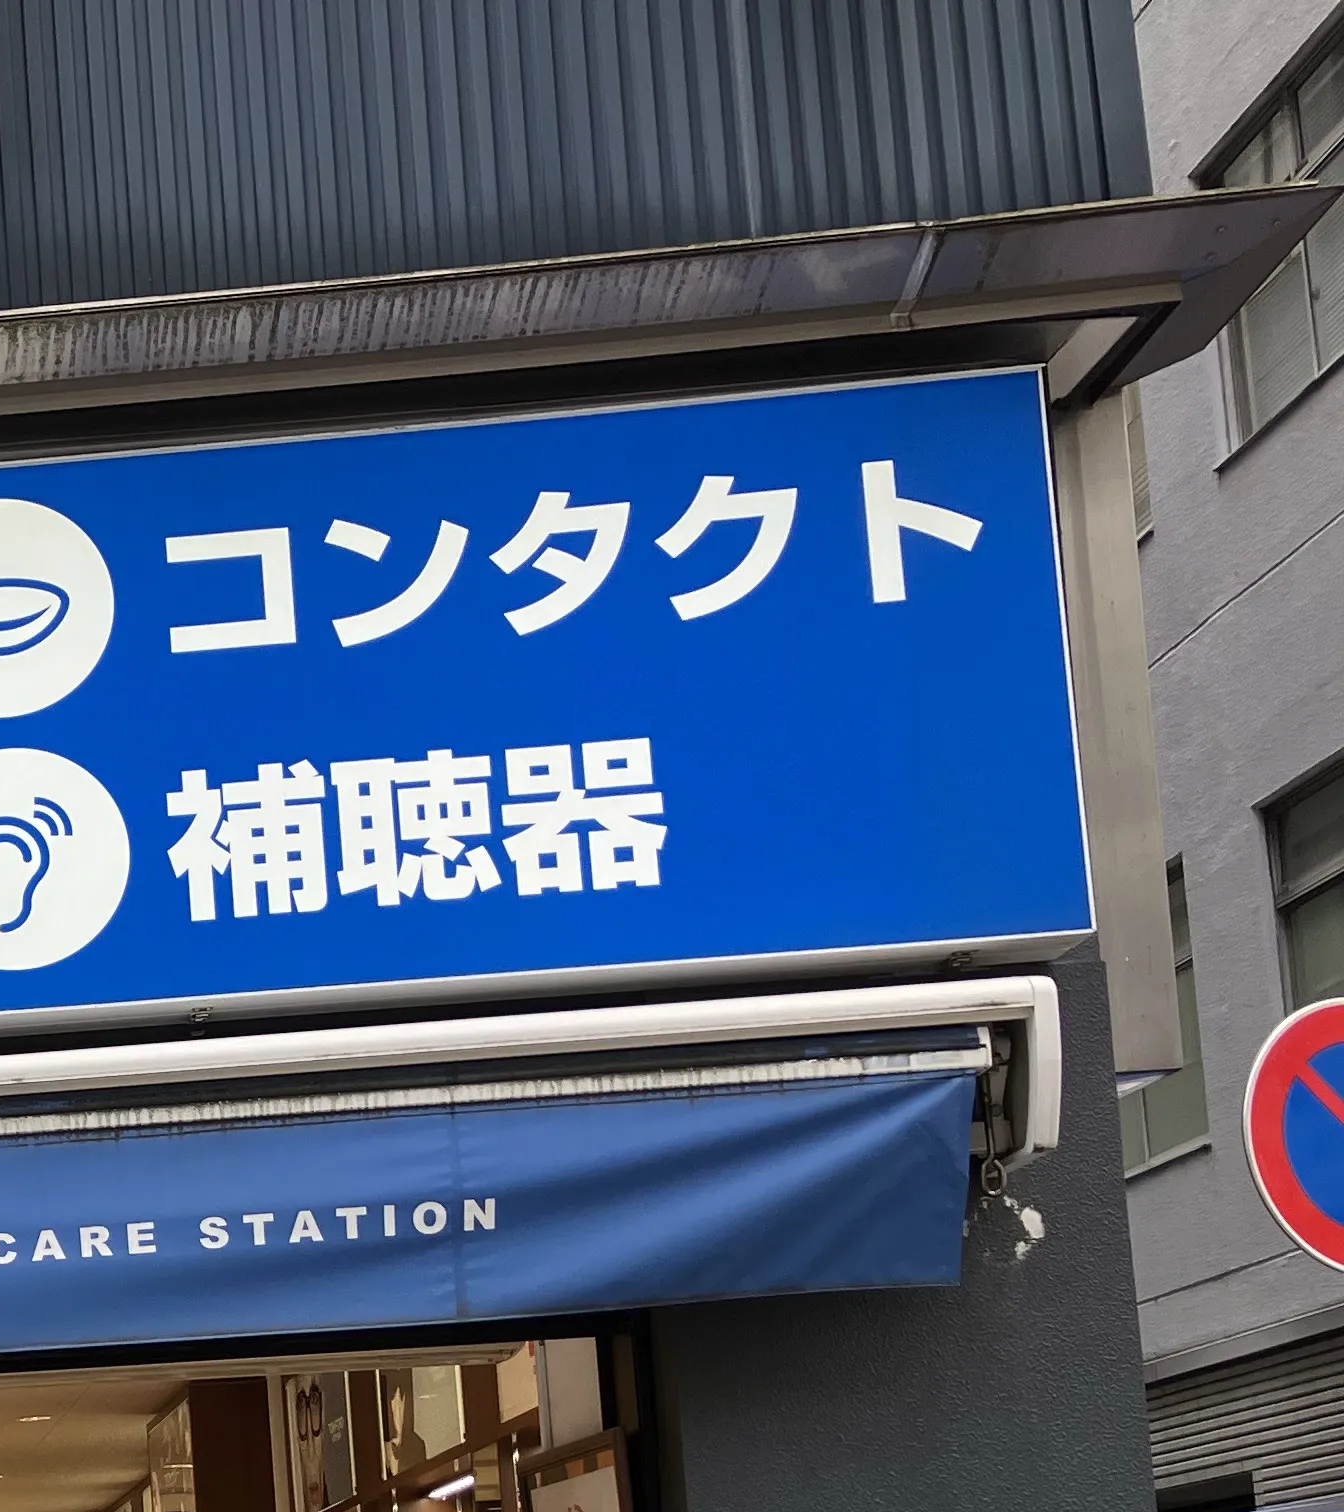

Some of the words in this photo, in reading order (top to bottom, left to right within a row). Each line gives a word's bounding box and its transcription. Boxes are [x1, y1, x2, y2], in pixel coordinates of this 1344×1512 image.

[165, 460, 984, 654] コンタクト
[165, 737, 667, 922] 補聴器
[198, 1197, 500, 1248] STATION
